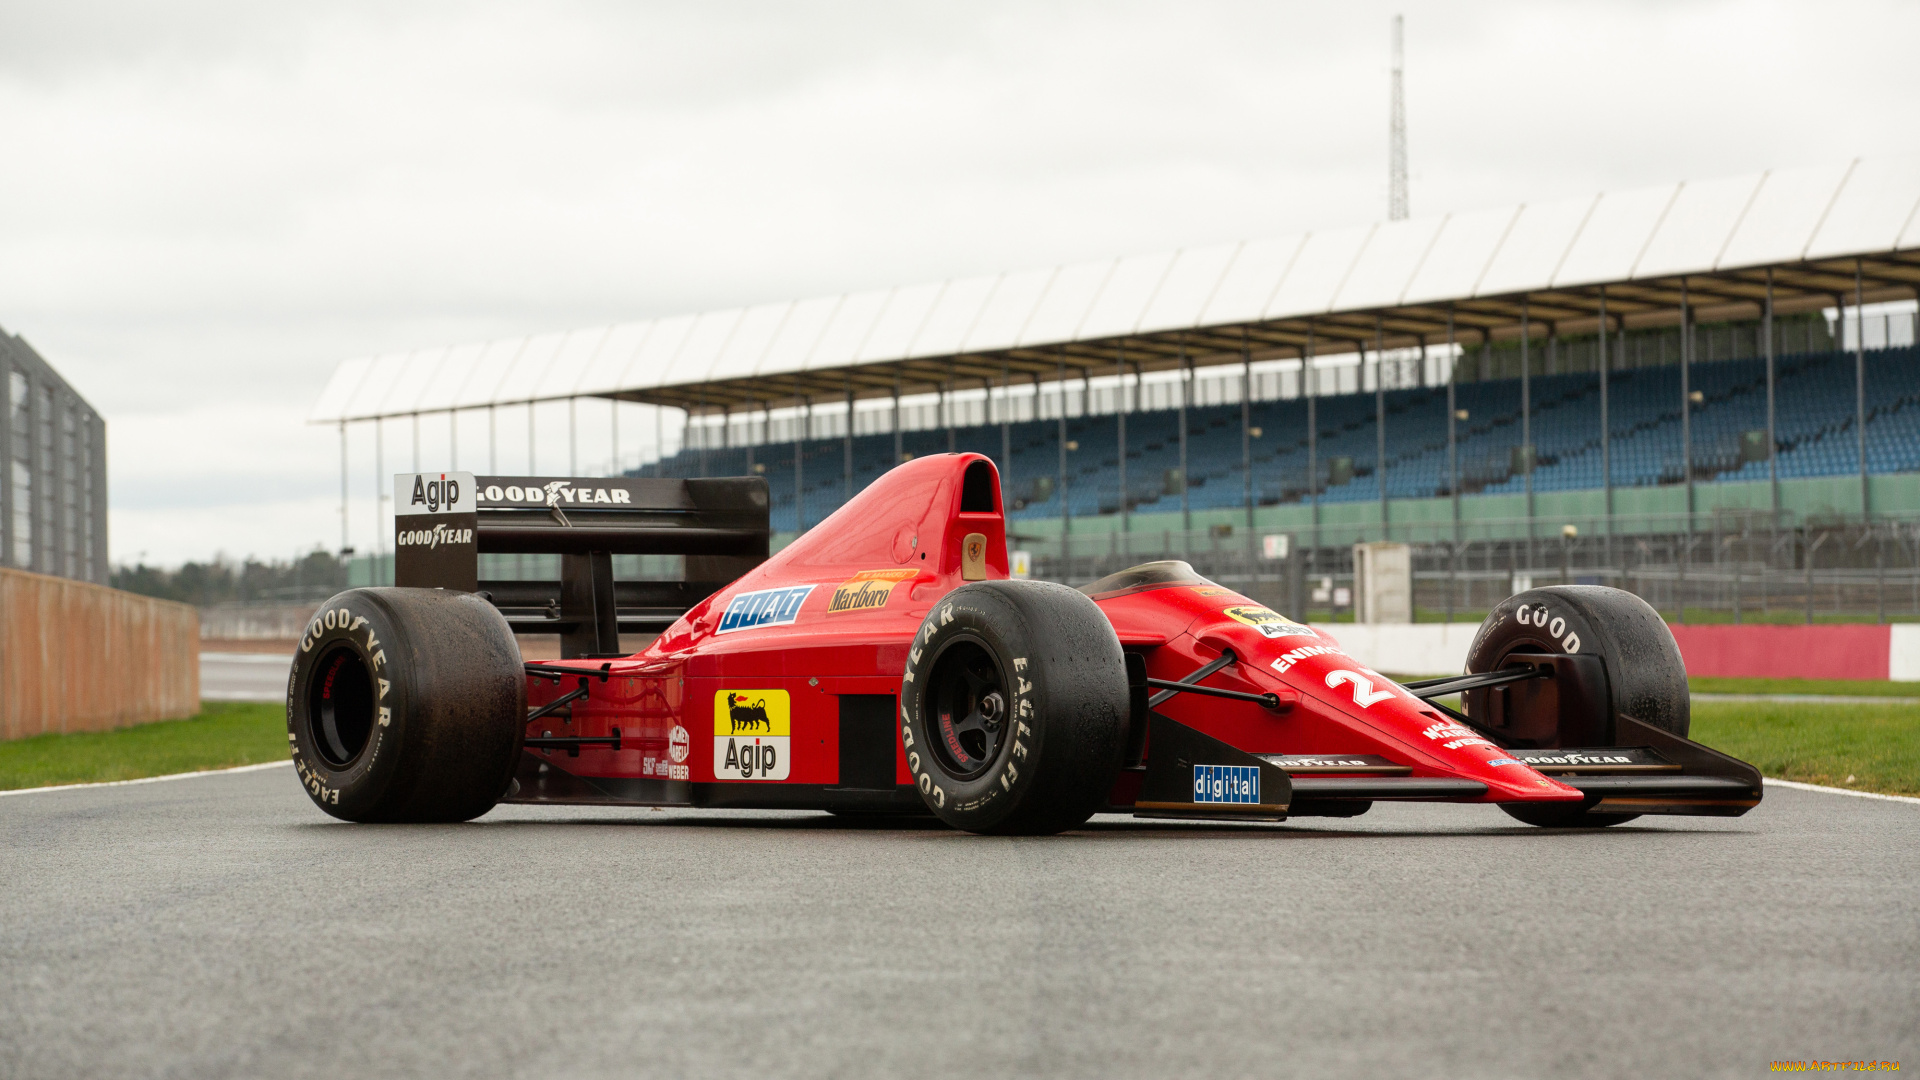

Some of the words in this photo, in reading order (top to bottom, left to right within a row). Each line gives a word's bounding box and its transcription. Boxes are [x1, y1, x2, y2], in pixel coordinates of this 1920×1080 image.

[411, 474, 459, 512] Agip
[725, 592, 804, 625] FIAT
[829, 581, 889, 611] Marlboro
[1516, 604, 1581, 655] GOOD
[941, 713, 969, 763] SPEEDLINE
[669, 765, 689, 779] WEBER
[724, 738, 776, 778] Agip
[1195, 775, 1256, 798] digital
